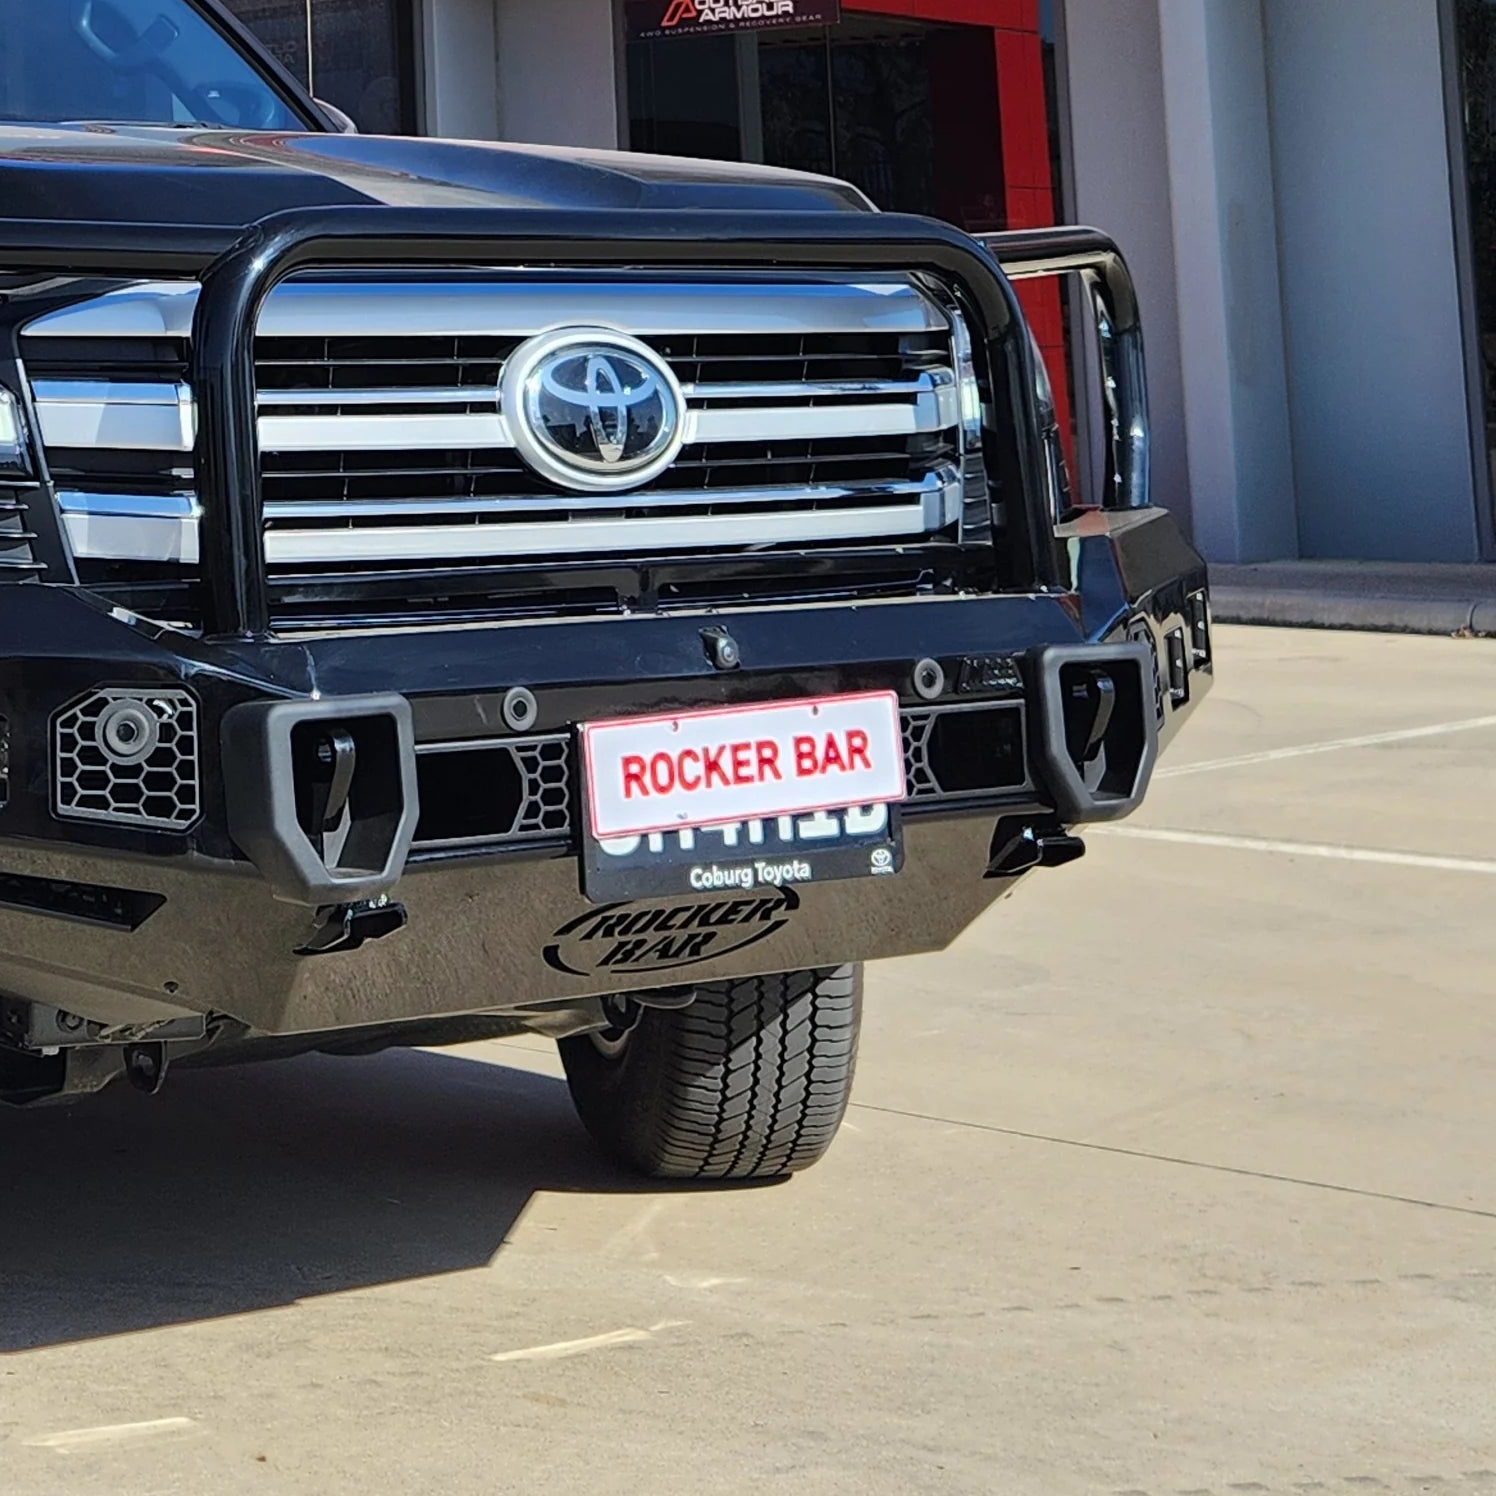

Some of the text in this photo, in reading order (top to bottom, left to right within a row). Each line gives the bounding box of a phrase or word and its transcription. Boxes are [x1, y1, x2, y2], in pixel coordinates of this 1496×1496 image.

[664, 23, 726, 36] SUSPENSION
[738, 16, 791, 28] RECOVERY
[795, 13, 823, 23] GEAR
[698, 0, 795, 23] ARMOUR
[621, 729, 872, 799] ROCKER BAR
[690, 860, 811, 890] Coburg Toyota
[579, 898, 788, 941] ROCKER
[596, 931, 717, 968] BAR
